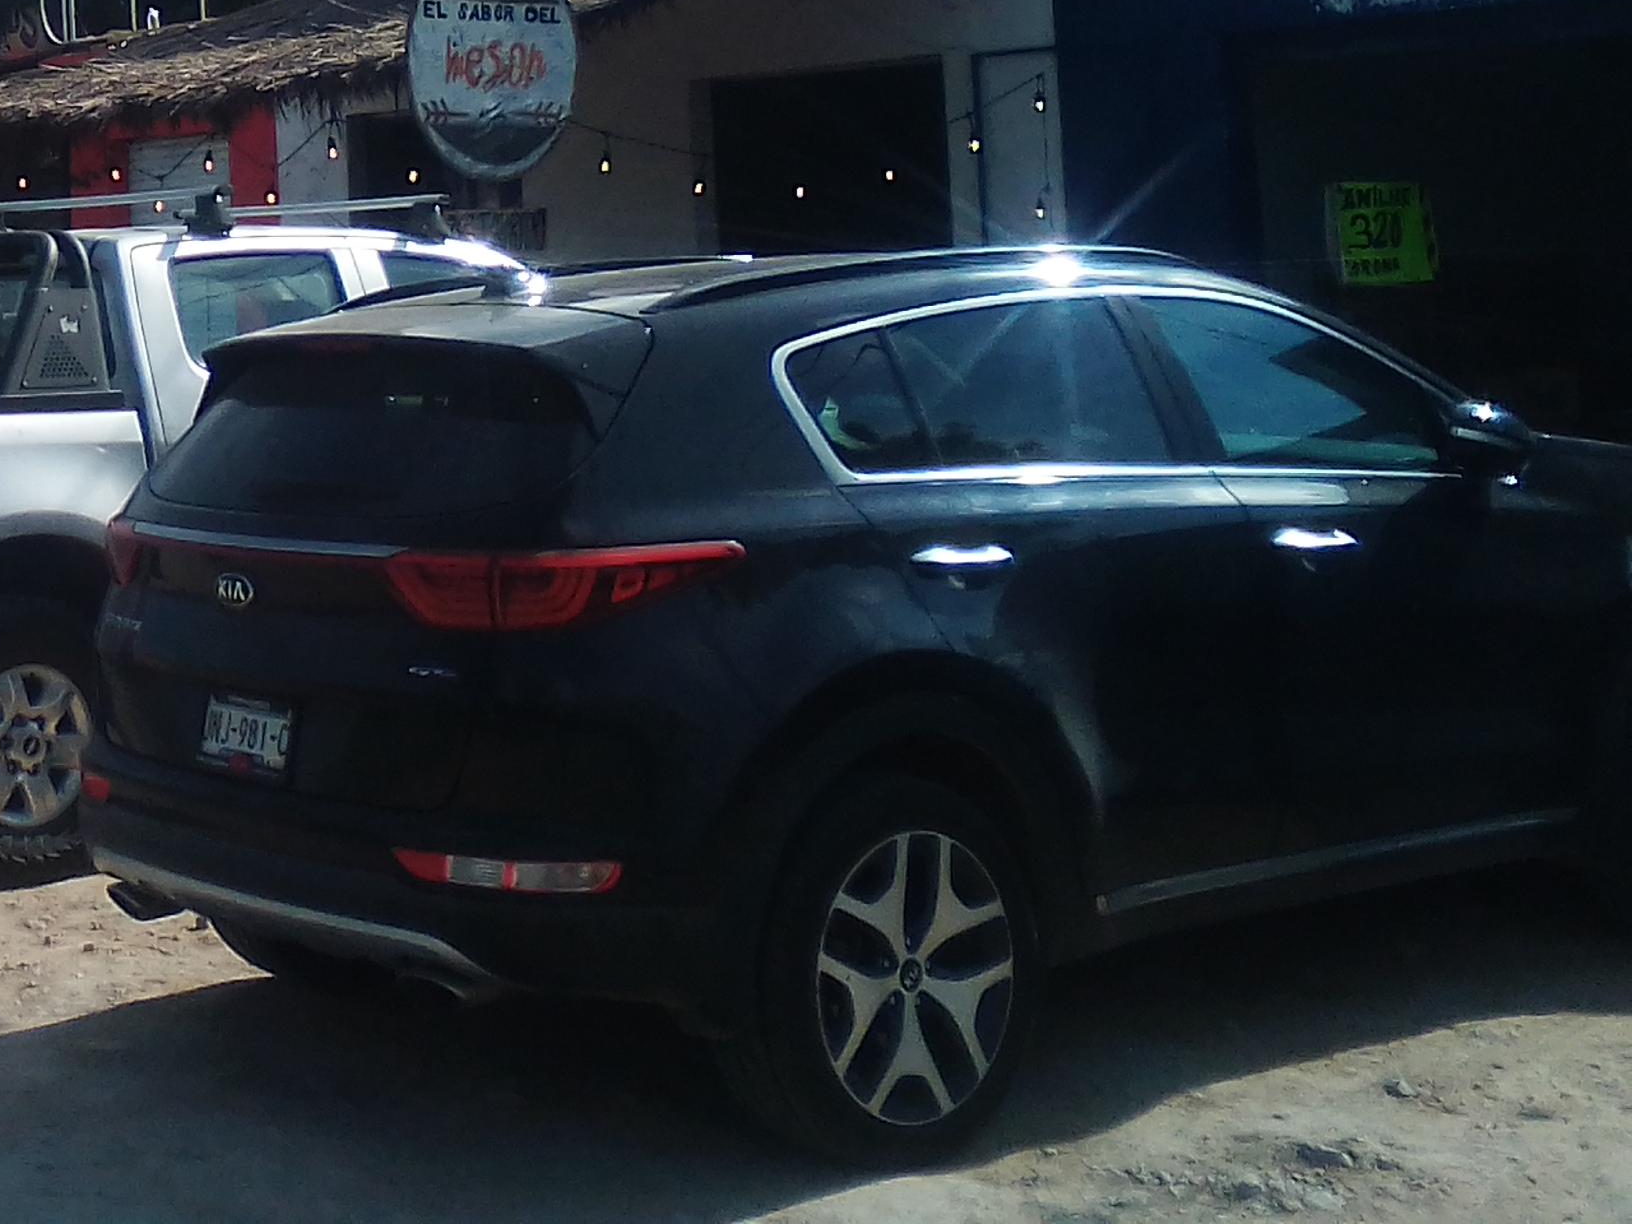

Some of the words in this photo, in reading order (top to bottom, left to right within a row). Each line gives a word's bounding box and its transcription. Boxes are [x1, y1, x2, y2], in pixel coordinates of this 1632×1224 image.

[423, 0, 447, 19] EL
[457, 2, 514, 22] SABOR
[524, 5, 561, 24] DEL
[218, 579, 246, 601] KIA
